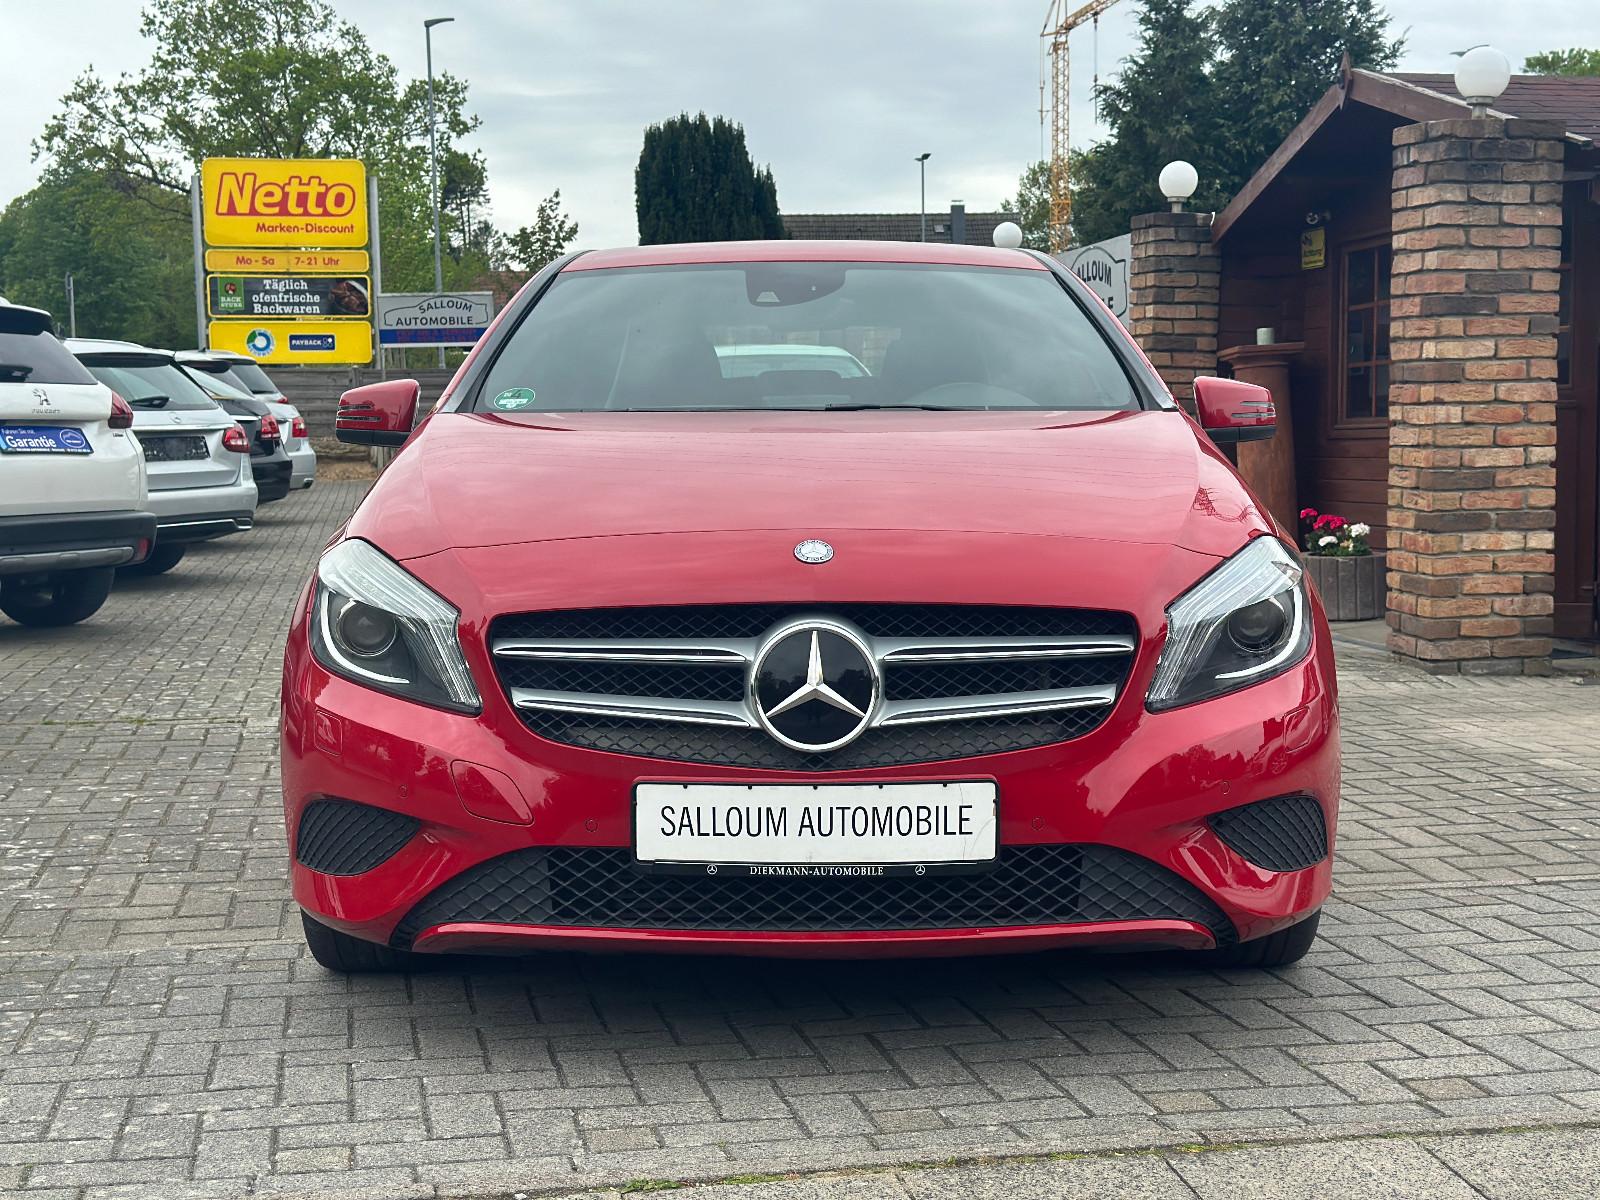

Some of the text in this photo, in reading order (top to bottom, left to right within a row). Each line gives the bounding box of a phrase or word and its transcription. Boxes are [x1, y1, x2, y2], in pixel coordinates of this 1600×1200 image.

[216, 172, 356, 217] Netto
[256, 223, 354, 234] Marken-Discount
[236, 256, 252, 266] Mo
[262, 256, 275, 266] Sa
[323, 256, 340, 266] Uhr
[1077, 260, 1112, 288] ALLOUM
[263, 279, 308, 292] Täglich
[252, 292, 320, 303] ofenfrische
[253, 304, 320, 314] Backwaren
[418, 300, 473, 314] SALLOUM
[396, 316, 474, 327] AUTOMOBILE
[5, 435, 57, 448] Garantie
[660, 804, 974, 838] SALLOUM AUTOMOBILE
[749, 866, 884, 877] DIEKMANN-AUTOMOBILE
